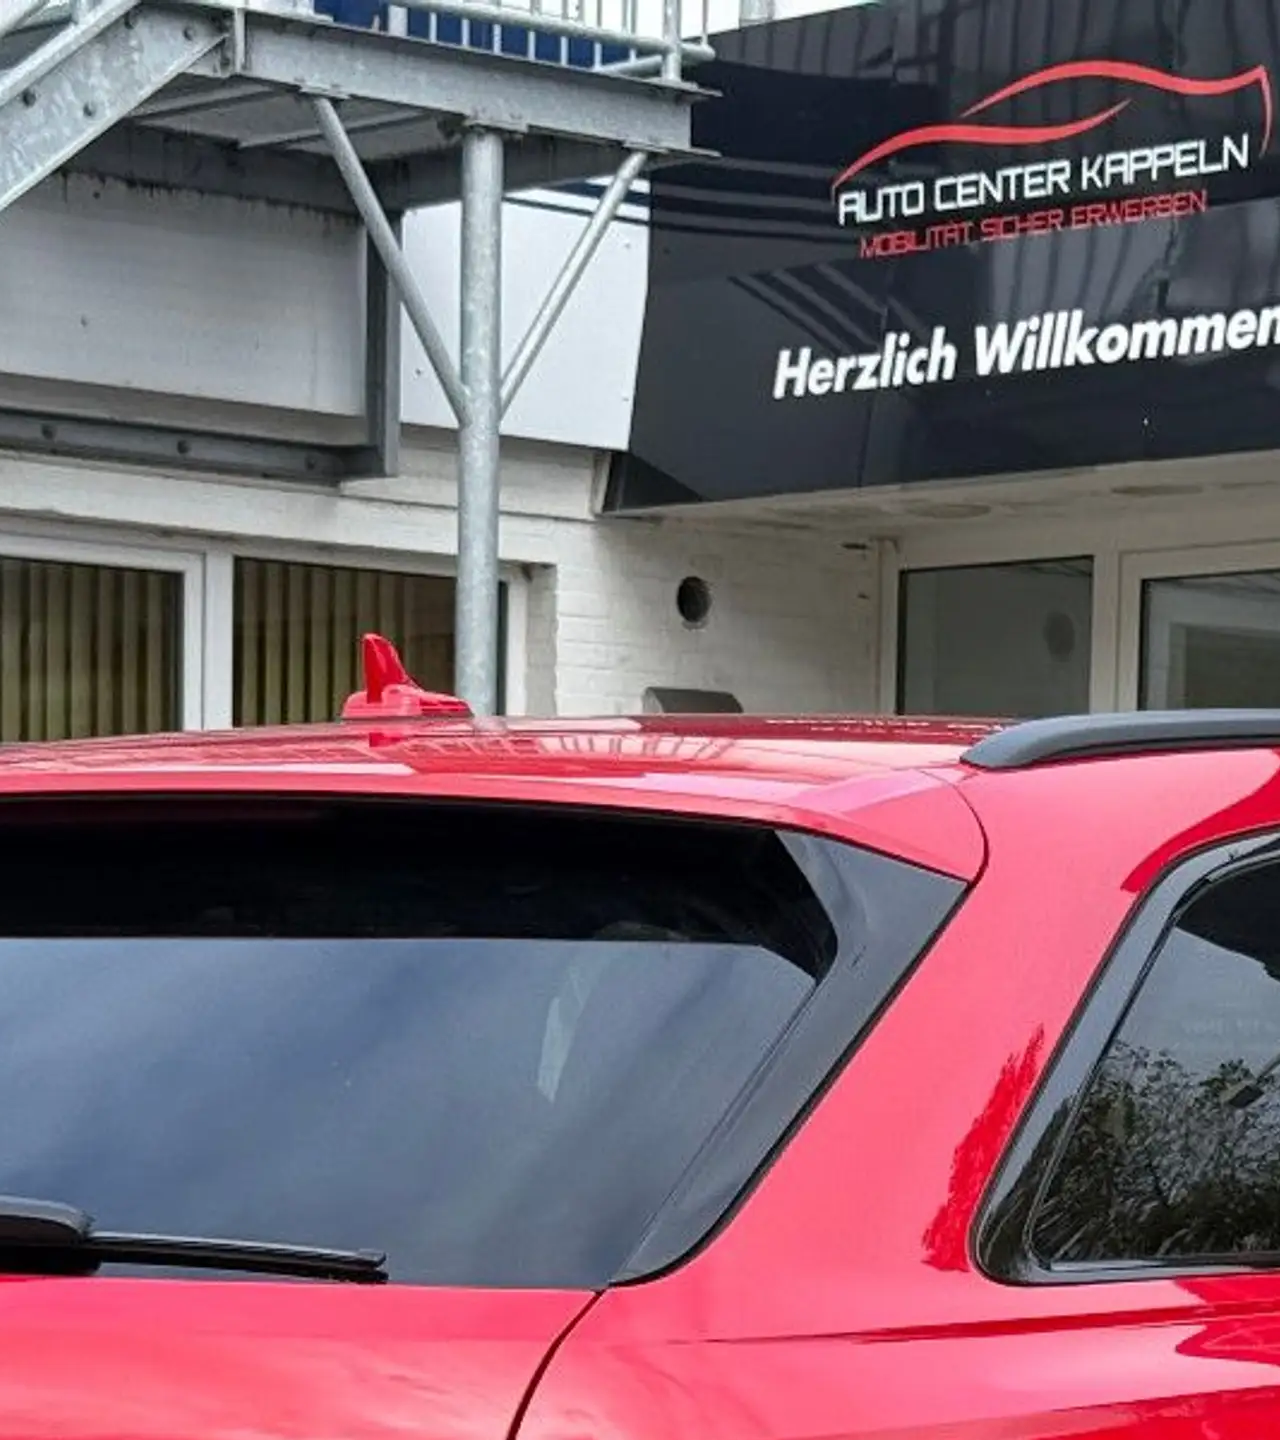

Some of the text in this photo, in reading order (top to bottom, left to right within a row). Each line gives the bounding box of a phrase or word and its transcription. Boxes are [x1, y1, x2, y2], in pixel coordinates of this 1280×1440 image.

[838, 134, 1250, 226] AUTO CENTER KAPPELN
[980, 209, 1064, 242] SICHER
[773, 326, 956, 399] Herzlich
